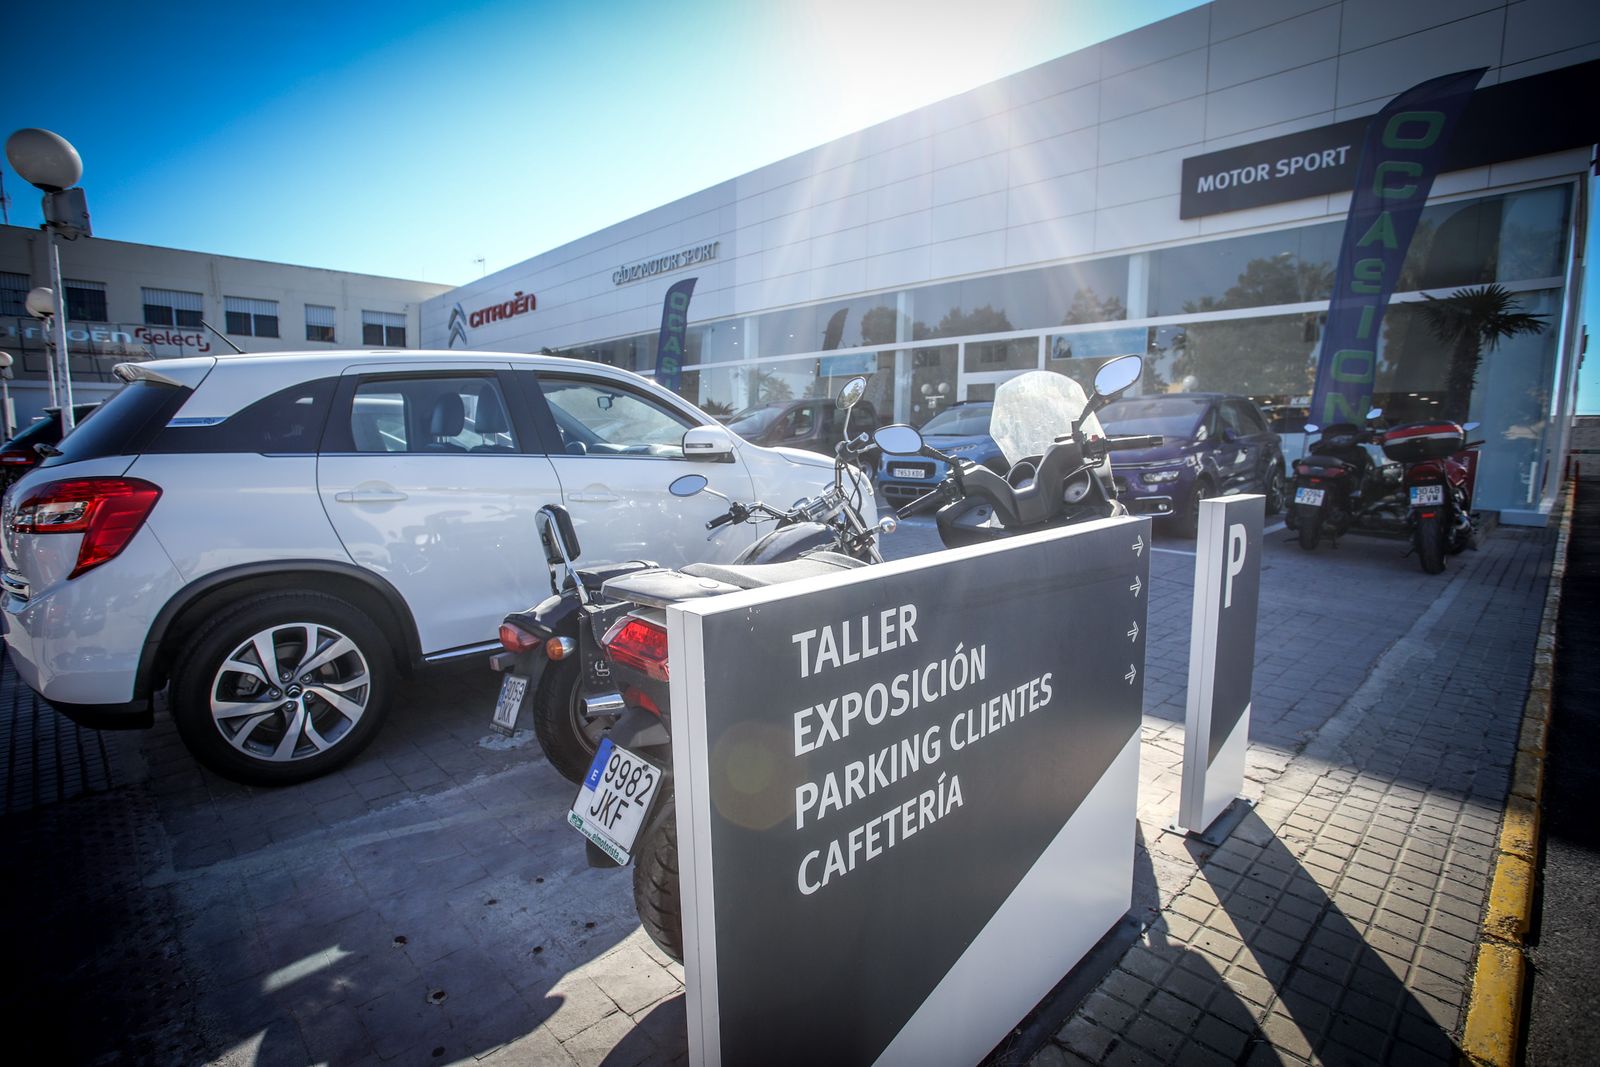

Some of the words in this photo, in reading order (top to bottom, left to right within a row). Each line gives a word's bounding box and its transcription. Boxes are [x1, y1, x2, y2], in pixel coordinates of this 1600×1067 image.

[1196, 163, 1270, 194] MOTOR
[1275, 145, 1351, 178] SPORT
[640, 254, 678, 279] MOTOR
[677, 241, 720, 267] SPORT
[1322, 111, 1446, 427] OCASION
[142, 330, 204, 347] select
[1224, 523, 1248, 609] P
[792, 603, 919, 679] TALLER
[793, 641, 986, 758] EXPOSICIÓN
[591, 769, 600, 782] E
[604, 753, 654, 807] 9982
[795, 725, 941, 831] PARKING
[950, 672, 1053, 751] CLIENTES
[590, 788, 629, 830] JKF
[797, 771, 964, 896] CAFETERÍA
